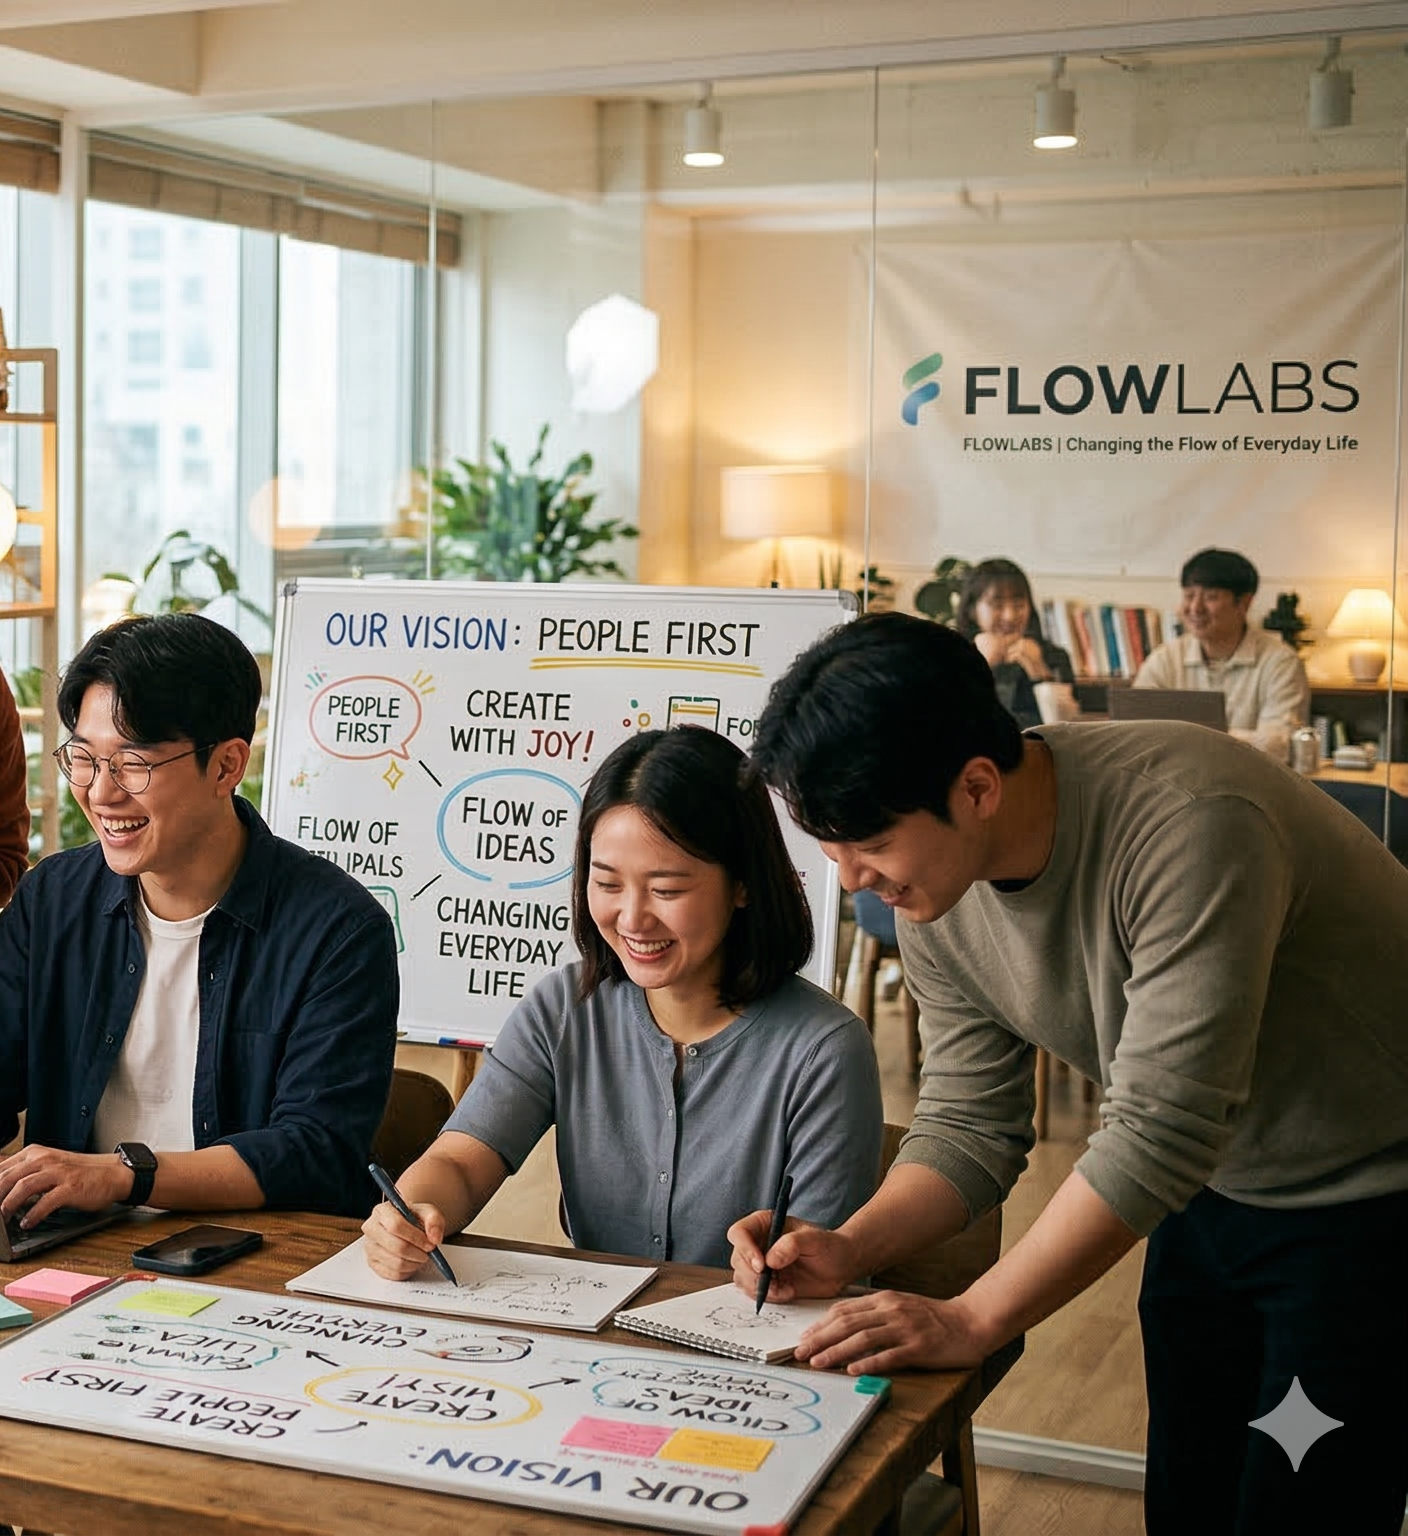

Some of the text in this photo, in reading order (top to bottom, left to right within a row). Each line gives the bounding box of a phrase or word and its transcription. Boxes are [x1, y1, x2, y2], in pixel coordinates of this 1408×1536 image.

[965, 360, 1360, 415] FLOWLABS
[963, 437, 1053, 451] FLOWLABS
[1066, 436, 1143, 454] Changing
[1147, 436, 1174, 451] the
[1179, 435, 1218, 451] Flow
[1222, 435, 1239, 451] of
[1243, 435, 1322, 454] Everyday
[1326, 435, 1359, 451] Life
[325, 612, 389, 649] OUR
[538, 617, 650, 654] PEOPLE
[666, 621, 761, 658] FIRST
[328, 695, 400, 719] PEOPLE
[466, 690, 572, 722] CREATE
[336, 722, 392, 745] FIRST
[450, 726, 595, 763] WITH JOY!
[463, 796, 569, 828] FLOW OF
[297, 816, 399, 845] FLOW OF
[476, 832, 556, 865] IDEAS
[437, 896, 572, 932] CHANGING
[439, 931, 564, 967] EVERYDAY
[468, 969, 526, 999] LIFE
[232, 1315, 407, 1348] CHANGING
[155, 1388, 301, 1421] PEOPLE
[336, 1388, 497, 1422] CREATE
[641, 1387, 752, 1412] IDEAS
[142, 1405, 286, 1439] CREATE
[407, 1446, 602, 1492] VISION:
[626, 1476, 749, 1513] OUR
